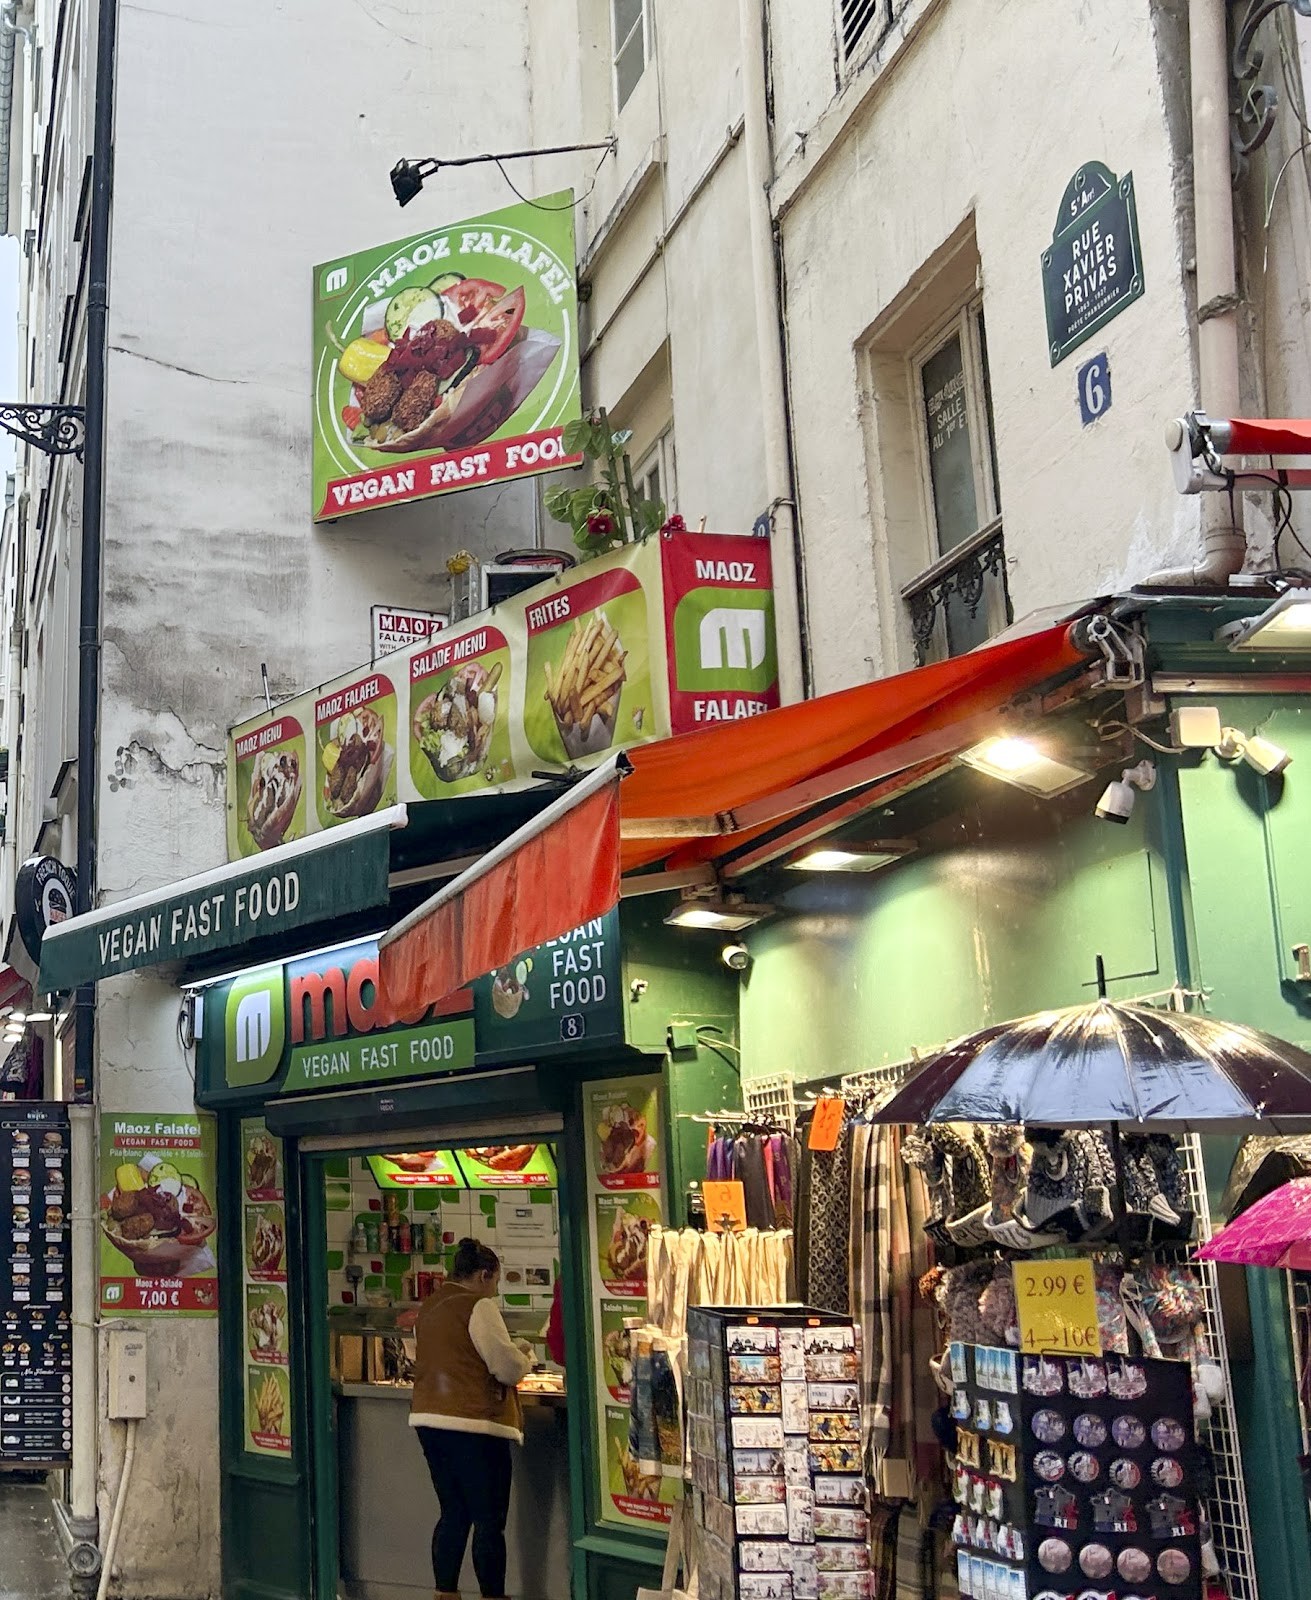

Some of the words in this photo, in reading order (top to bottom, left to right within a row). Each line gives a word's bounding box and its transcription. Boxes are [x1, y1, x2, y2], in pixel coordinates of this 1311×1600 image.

[1072, 220, 1100, 261] RUE
[366, 236, 451, 298] MAOZ
[460, 231, 572, 305] FALAFEL
[1063, 233, 1115, 292] XAVIER
[1065, 256, 1117, 314] PRIVAS
[1086, 364, 1104, 415] 6
[937, 397, 962, 430] SALLE
[332, 469, 415, 506] VEGAN
[430, 453, 491, 485] FAST
[695, 559, 756, 583] MAOZ
[381, 615, 439, 634] MAOZ
[529, 595, 570, 630] FRITES
[379, 632, 421, 643] FALAFE
[412, 646, 450, 679] SALADE
[453, 631, 487, 661] MENU
[317, 695, 343, 722] MAOZ
[344, 678, 380, 711] FALAFEL
[236, 735, 258, 757] MAOZ
[259, 723, 282, 748] MENU
[99, 914, 162, 966] VEGAN
[171, 894, 225, 945] FAST
[234, 871, 300, 927] FOOD
[552, 941, 604, 977] FAST
[290, 959, 474, 1044] ma
[550, 974, 606, 1009] FOOD
[567, 1018, 577, 1036] 8
[303, 1050, 350, 1079] VEGAN
[361, 1043, 399, 1071] FAST
[410, 1035, 454, 1064] FOOD
[114, 1122, 151, 1134] Maoz
[155, 1122, 202, 1135] Falafel
[121, 1137, 146, 1146] VEGAN
[151, 1138, 169, 1146] FAST
[174, 1138, 194, 1147] FOOD
[140, 1290, 167, 1308] 7,00
[171, 1290, 179, 1305] €
[160, 1279, 183, 1288] Salade
[1025, 1275, 1067, 1297] 2.99
[1073, 1274, 1085, 1295] €
[1024, 1328, 1035, 1348] 4
